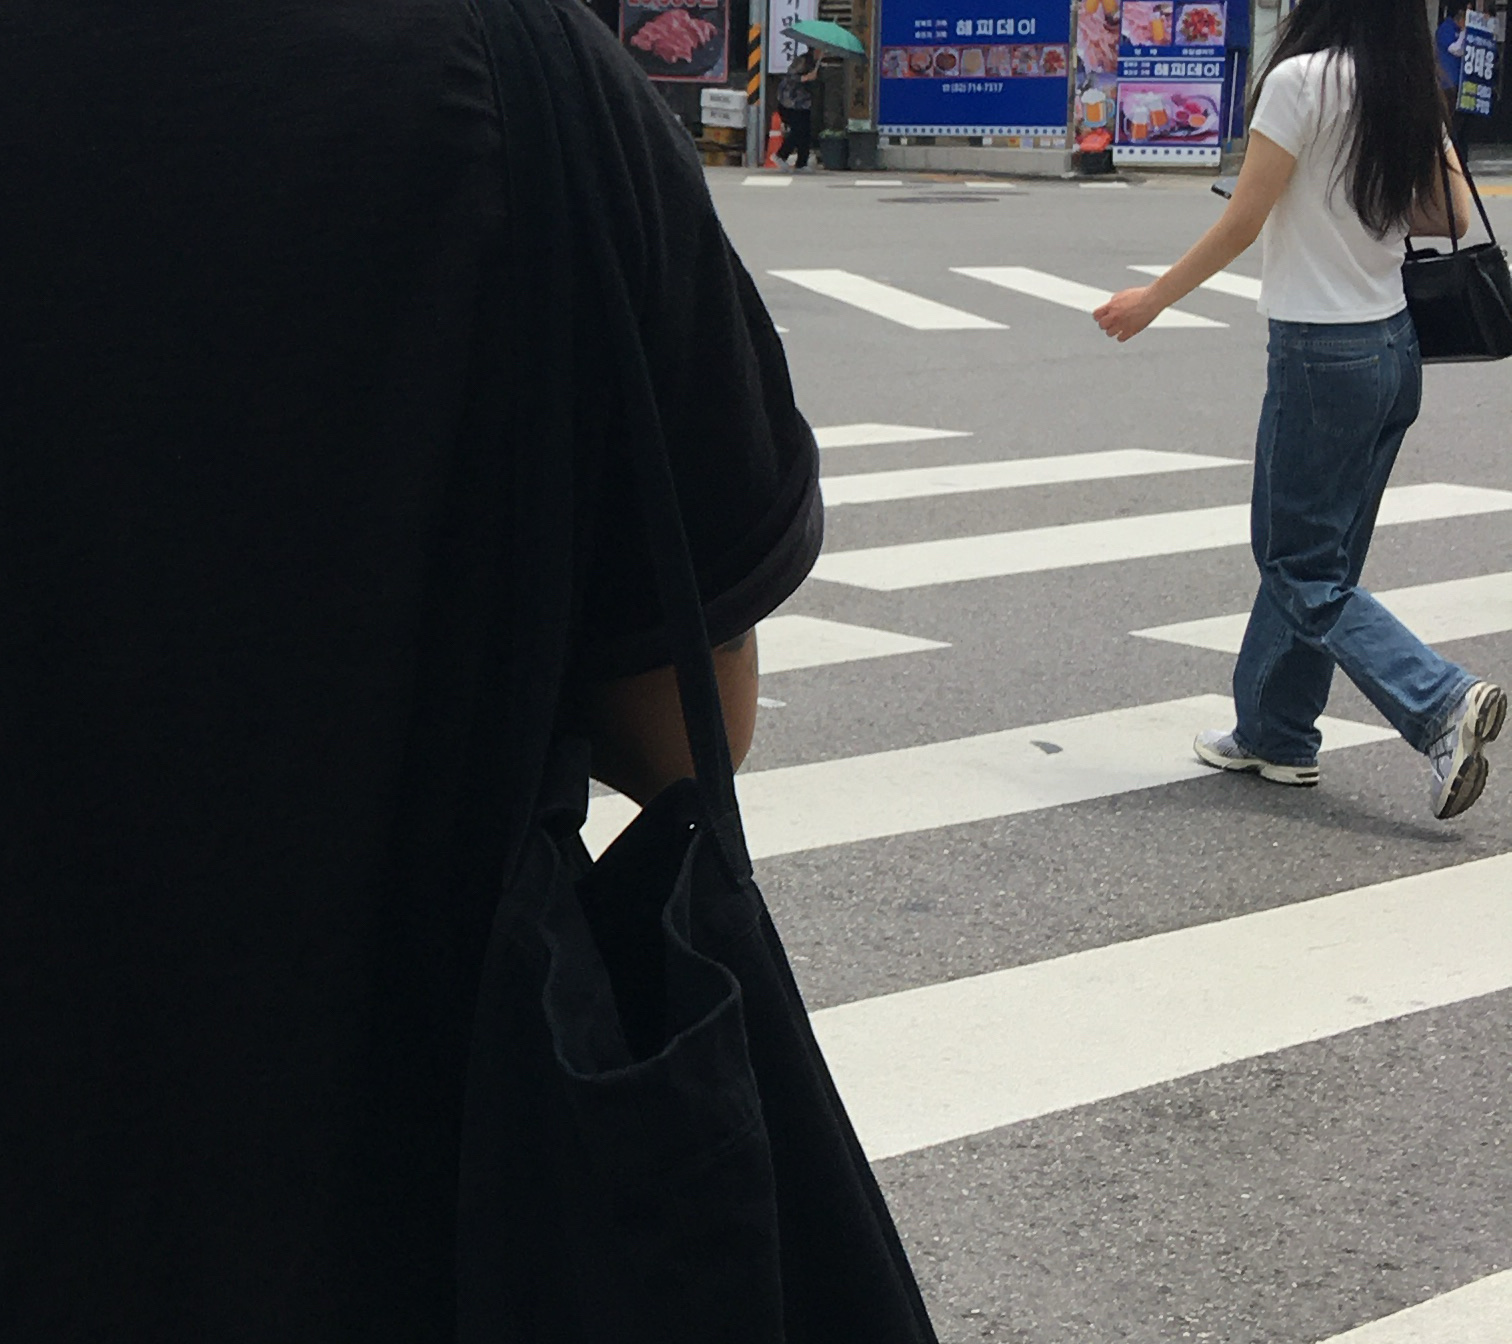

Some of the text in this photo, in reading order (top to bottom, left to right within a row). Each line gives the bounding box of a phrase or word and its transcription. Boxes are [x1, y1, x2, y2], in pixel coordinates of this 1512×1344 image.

[956, 18, 1036, 36] 해피데이
[1154, 62, 1220, 77] 해피데이
[1464, 44, 1495, 81] 강태웅
